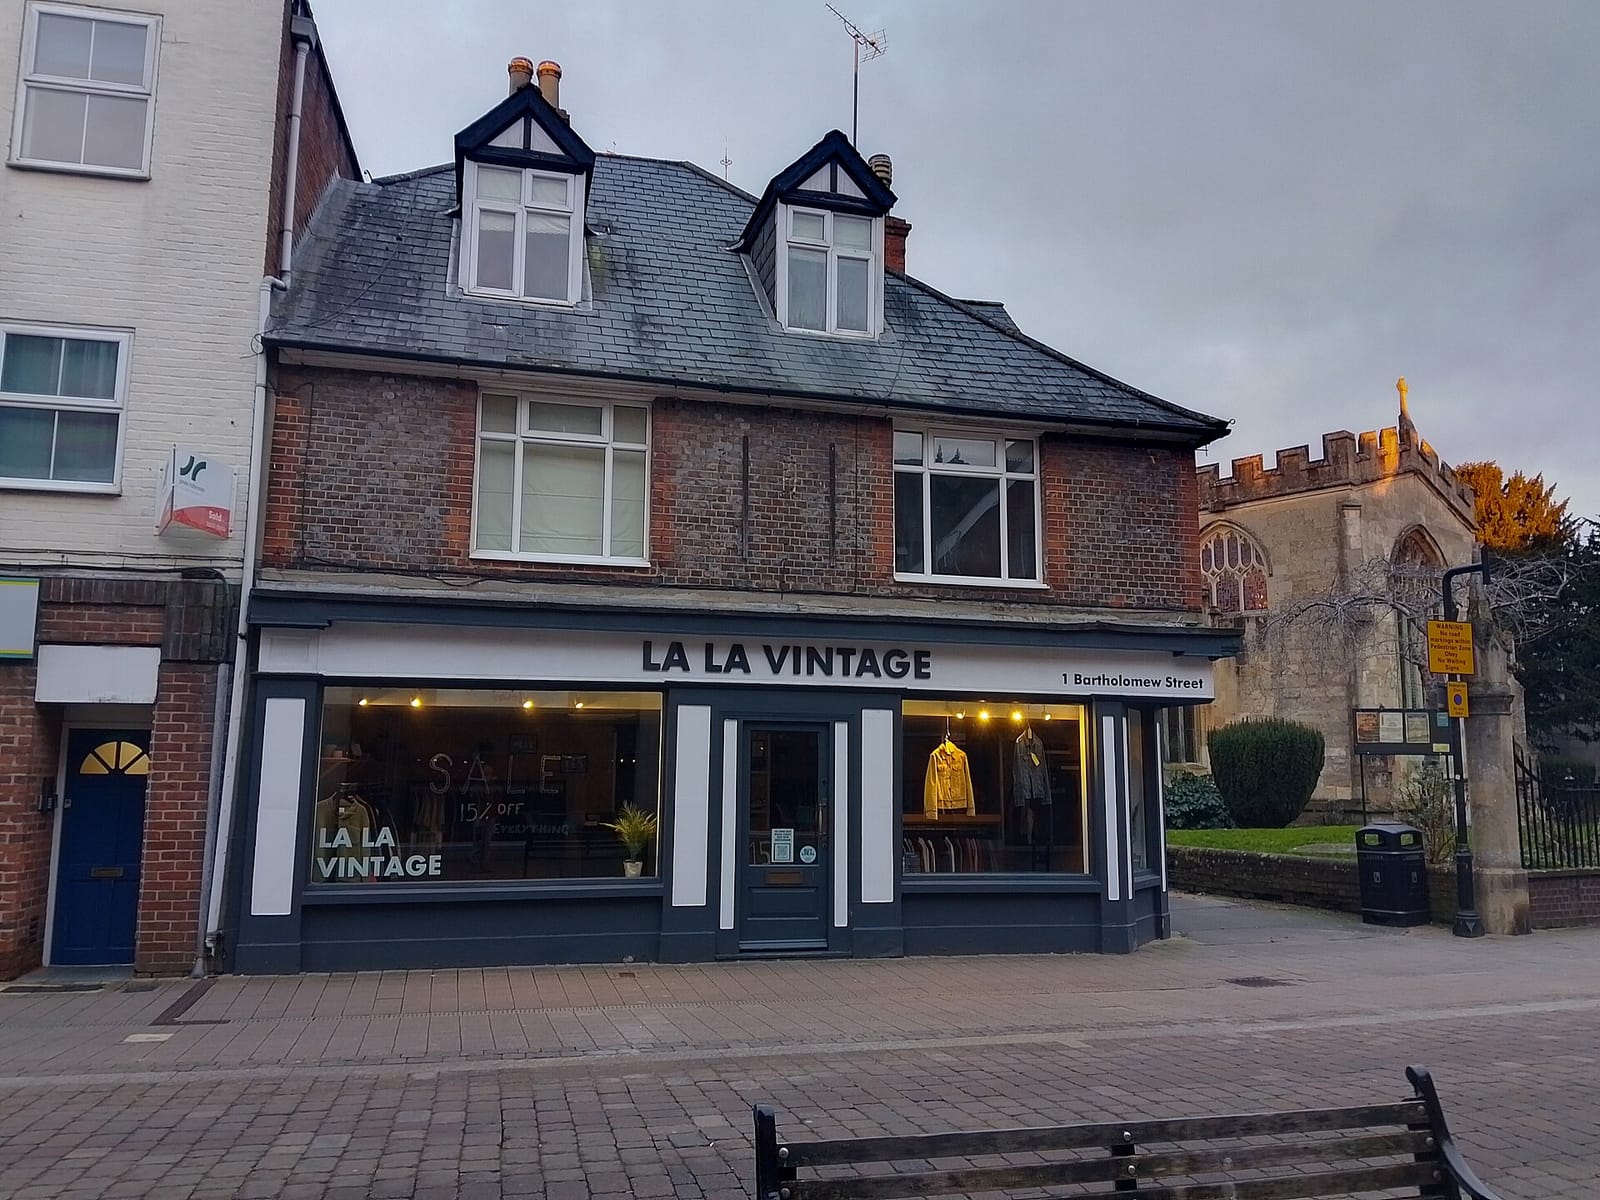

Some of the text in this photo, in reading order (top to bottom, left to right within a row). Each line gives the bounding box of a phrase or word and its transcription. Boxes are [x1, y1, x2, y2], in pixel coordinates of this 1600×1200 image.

[642, 640, 931, 679] LA LA VINTAGE
[1446, 658, 1466, 666] Waiting
[1062, 673, 1204, 689] 1 Bartholomew Street
[428, 752, 562, 795] SALE
[460, 802, 525, 823] 15% OFF
[319, 826, 395, 848] LA LA
[317, 854, 442, 878] VINTAGE
